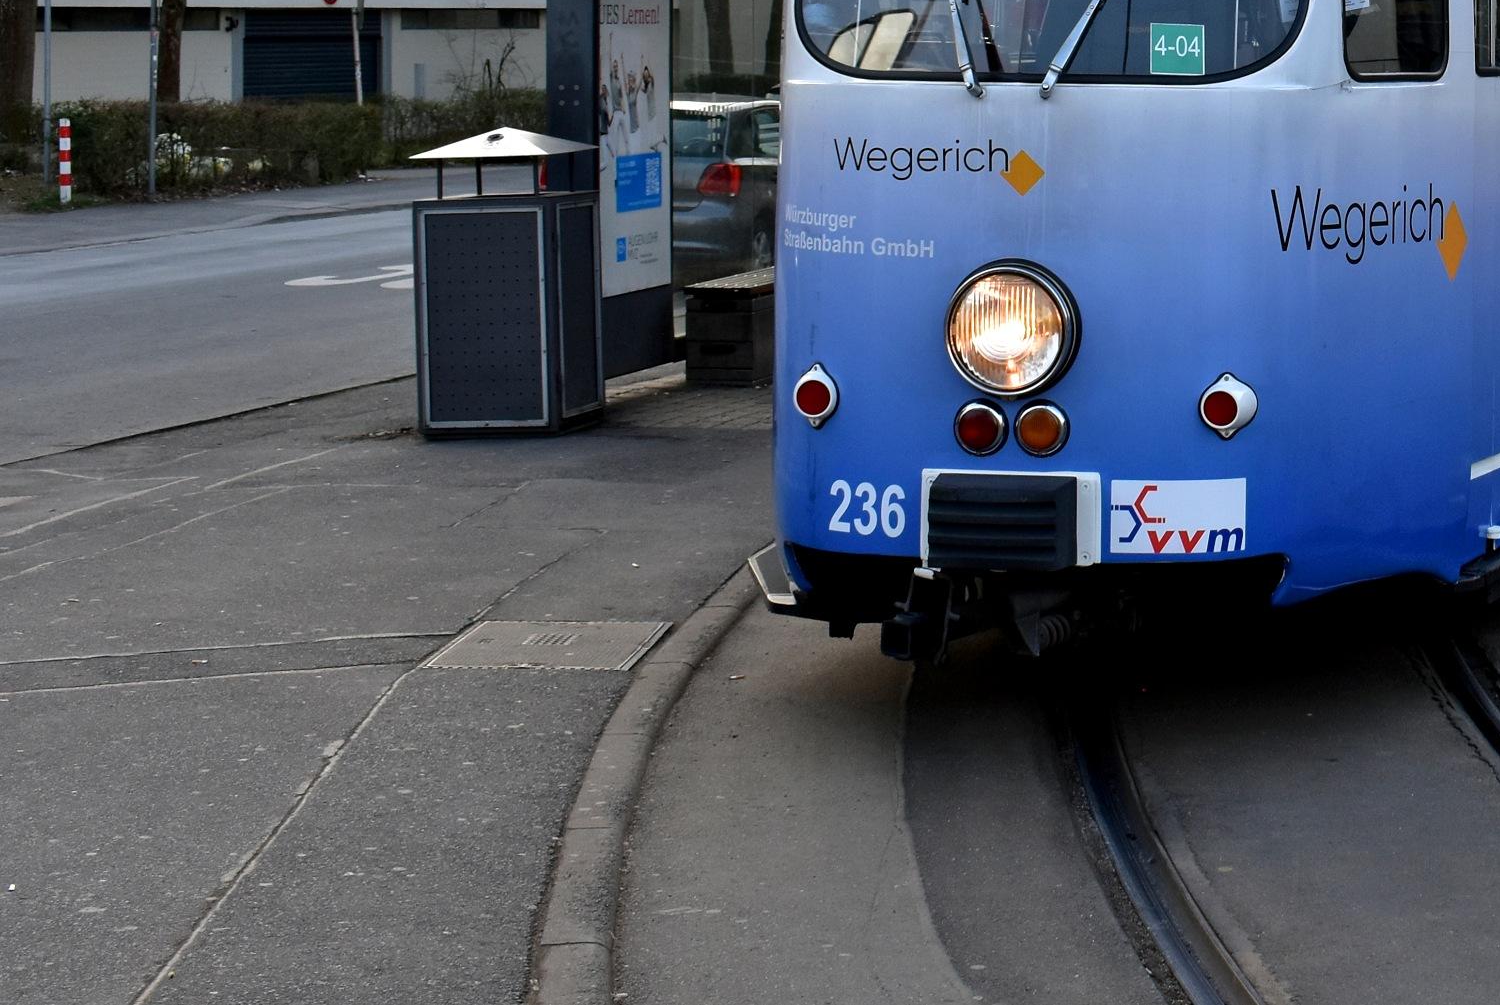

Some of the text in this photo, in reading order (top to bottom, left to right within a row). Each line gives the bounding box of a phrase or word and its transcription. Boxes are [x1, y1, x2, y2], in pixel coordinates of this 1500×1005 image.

[600, 4, 660, 25] UES Lernen!
[1154, 35, 1201, 58] 4-04
[834, 137, 1009, 181] Wegerich
[785, 203, 857, 232] Würzburger
[1271, 183, 1444, 264] Wegerich
[784, 228, 934, 258] Straßenbahn GmbH
[829, 480, 906, 538] 236
[1147, 527, 1244, 555] vvm
